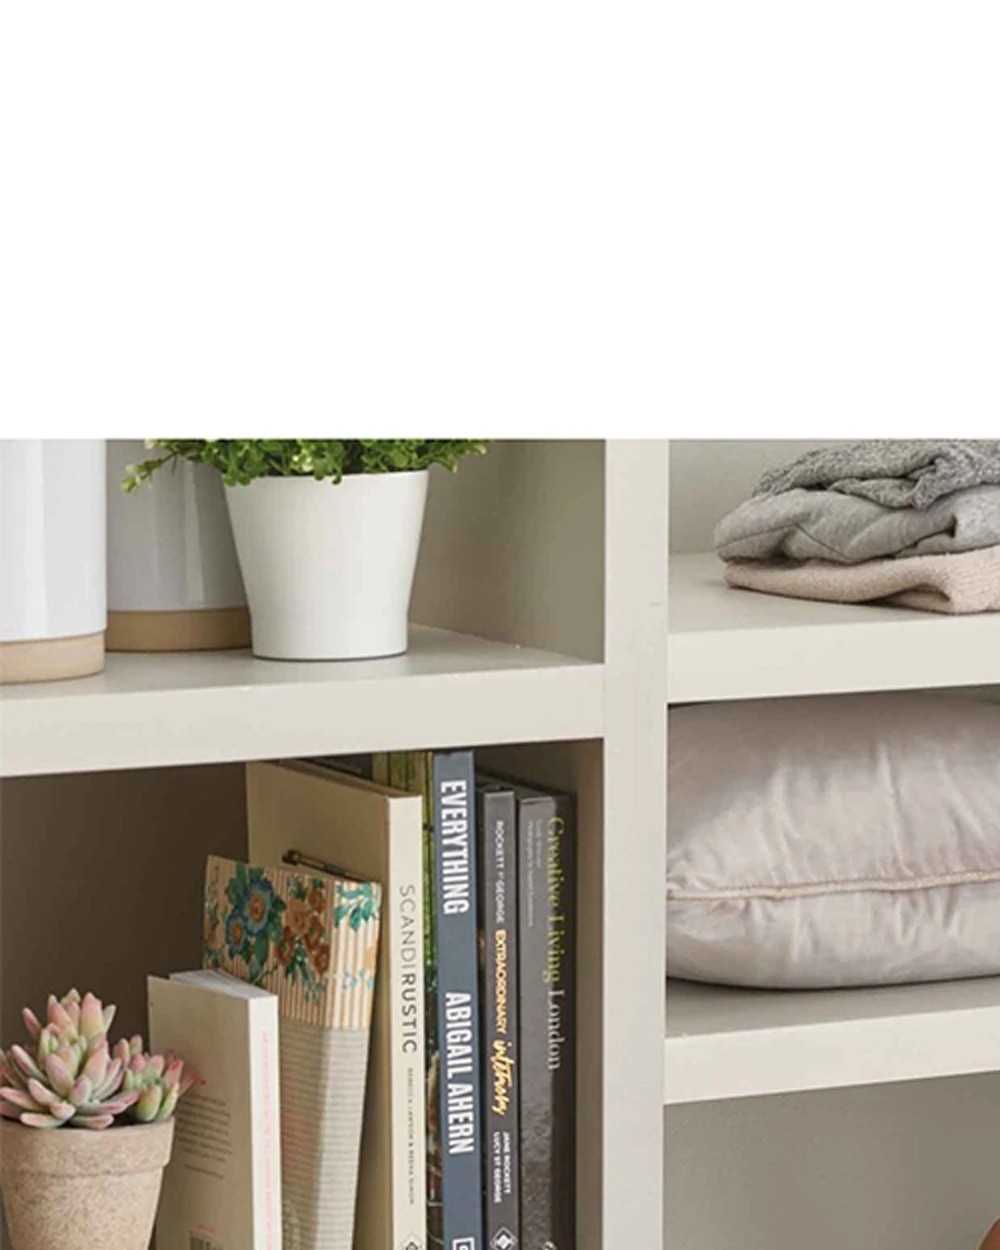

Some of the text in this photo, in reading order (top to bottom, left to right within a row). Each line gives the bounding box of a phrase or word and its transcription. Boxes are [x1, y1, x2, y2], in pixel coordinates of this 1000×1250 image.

[440, 780, 470, 915] EVERYTHING
[495, 820, 505, 869] ROCKETT
[495, 880, 505, 924] GEORGE
[495, 929, 507, 1034] EXTRAORDINARY
[542, 817, 565, 1070] Creative Living London
[445, 992, 475, 1155] ABIGAIL AHERN
